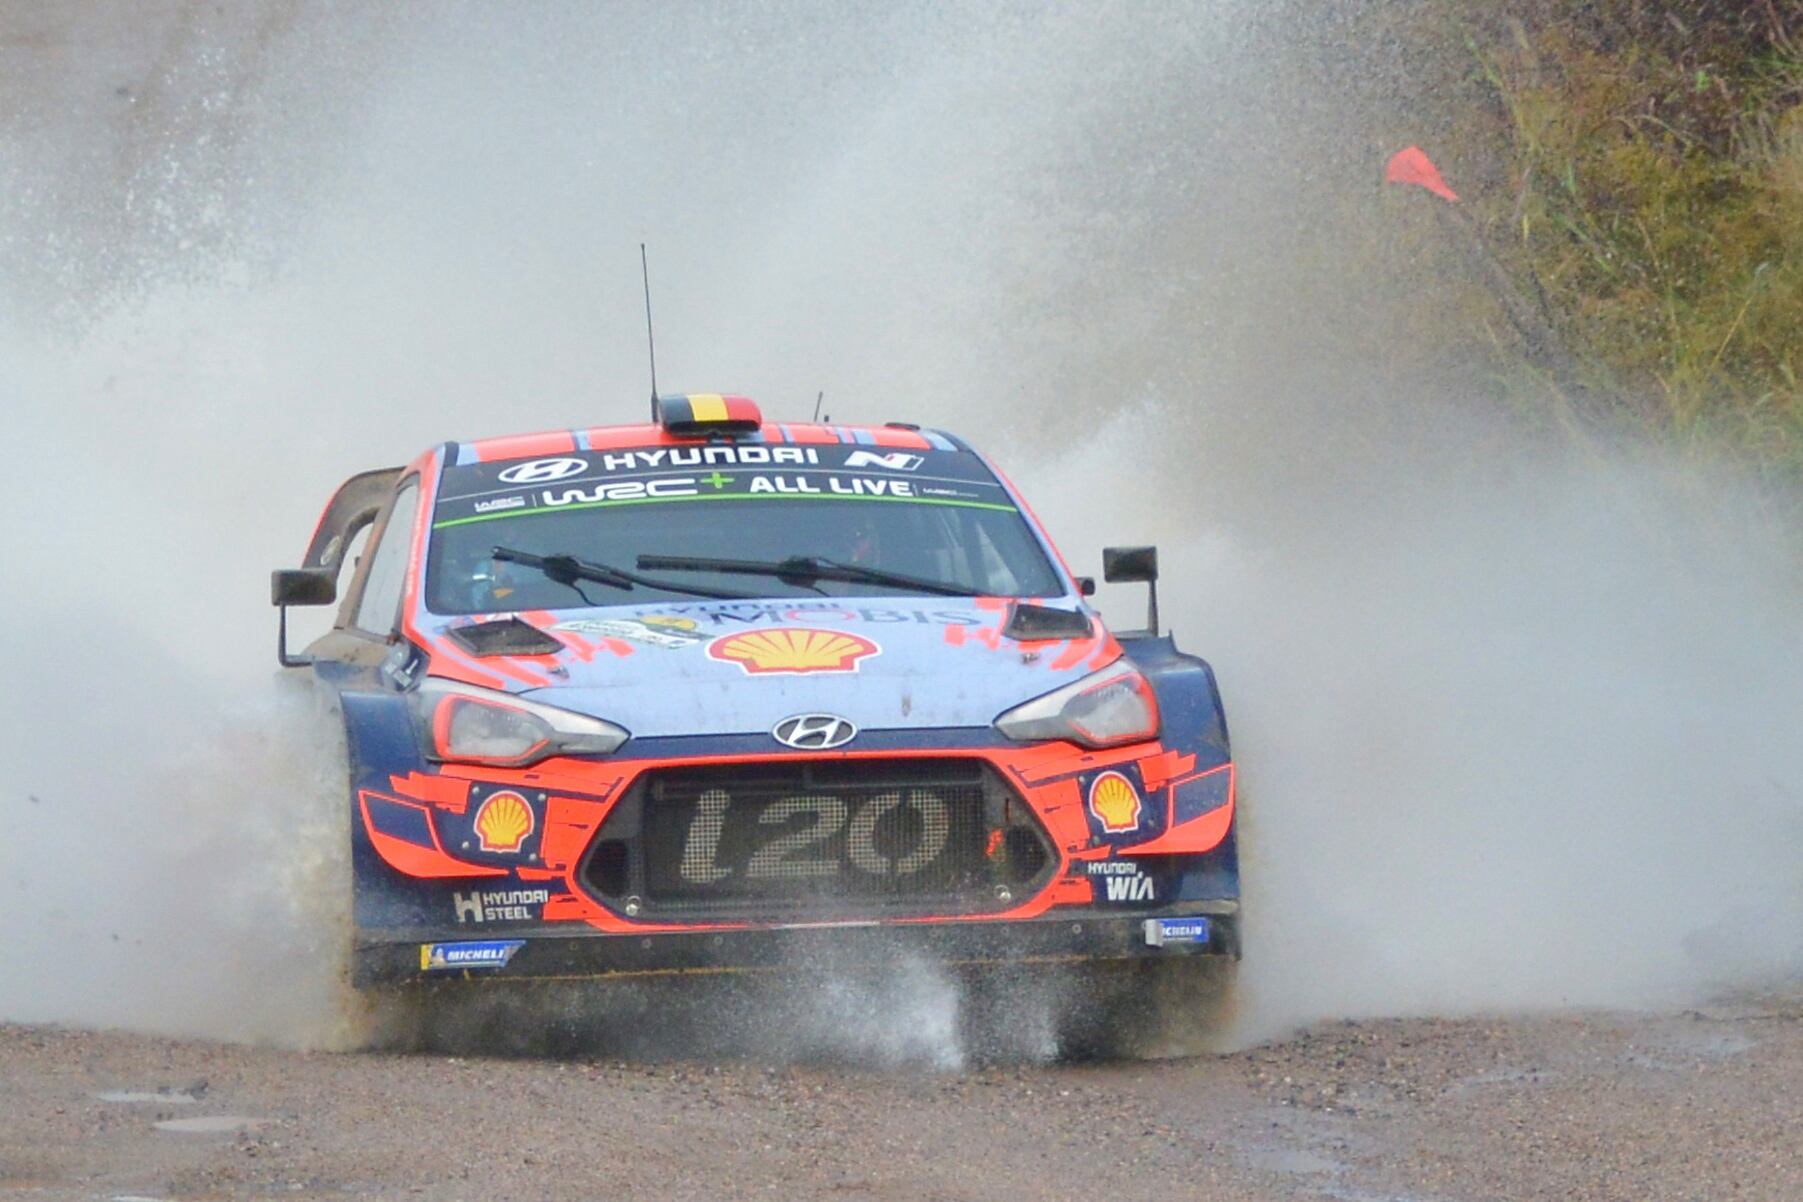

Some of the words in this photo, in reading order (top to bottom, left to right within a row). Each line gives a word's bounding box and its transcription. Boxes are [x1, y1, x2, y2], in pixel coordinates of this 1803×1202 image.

[603, 447, 819, 471] HYUNDAI
[750, 476, 821, 493] ALL
[829, 477, 914, 497] LIVE
[710, 608, 981, 626] MOBIS
[1088, 862, 1137, 875] HYUNDAI
[483, 889, 549, 906] HYUNDAI
[484, 906, 533, 921] STEEL
[447, 948, 508, 961] MICHELI
